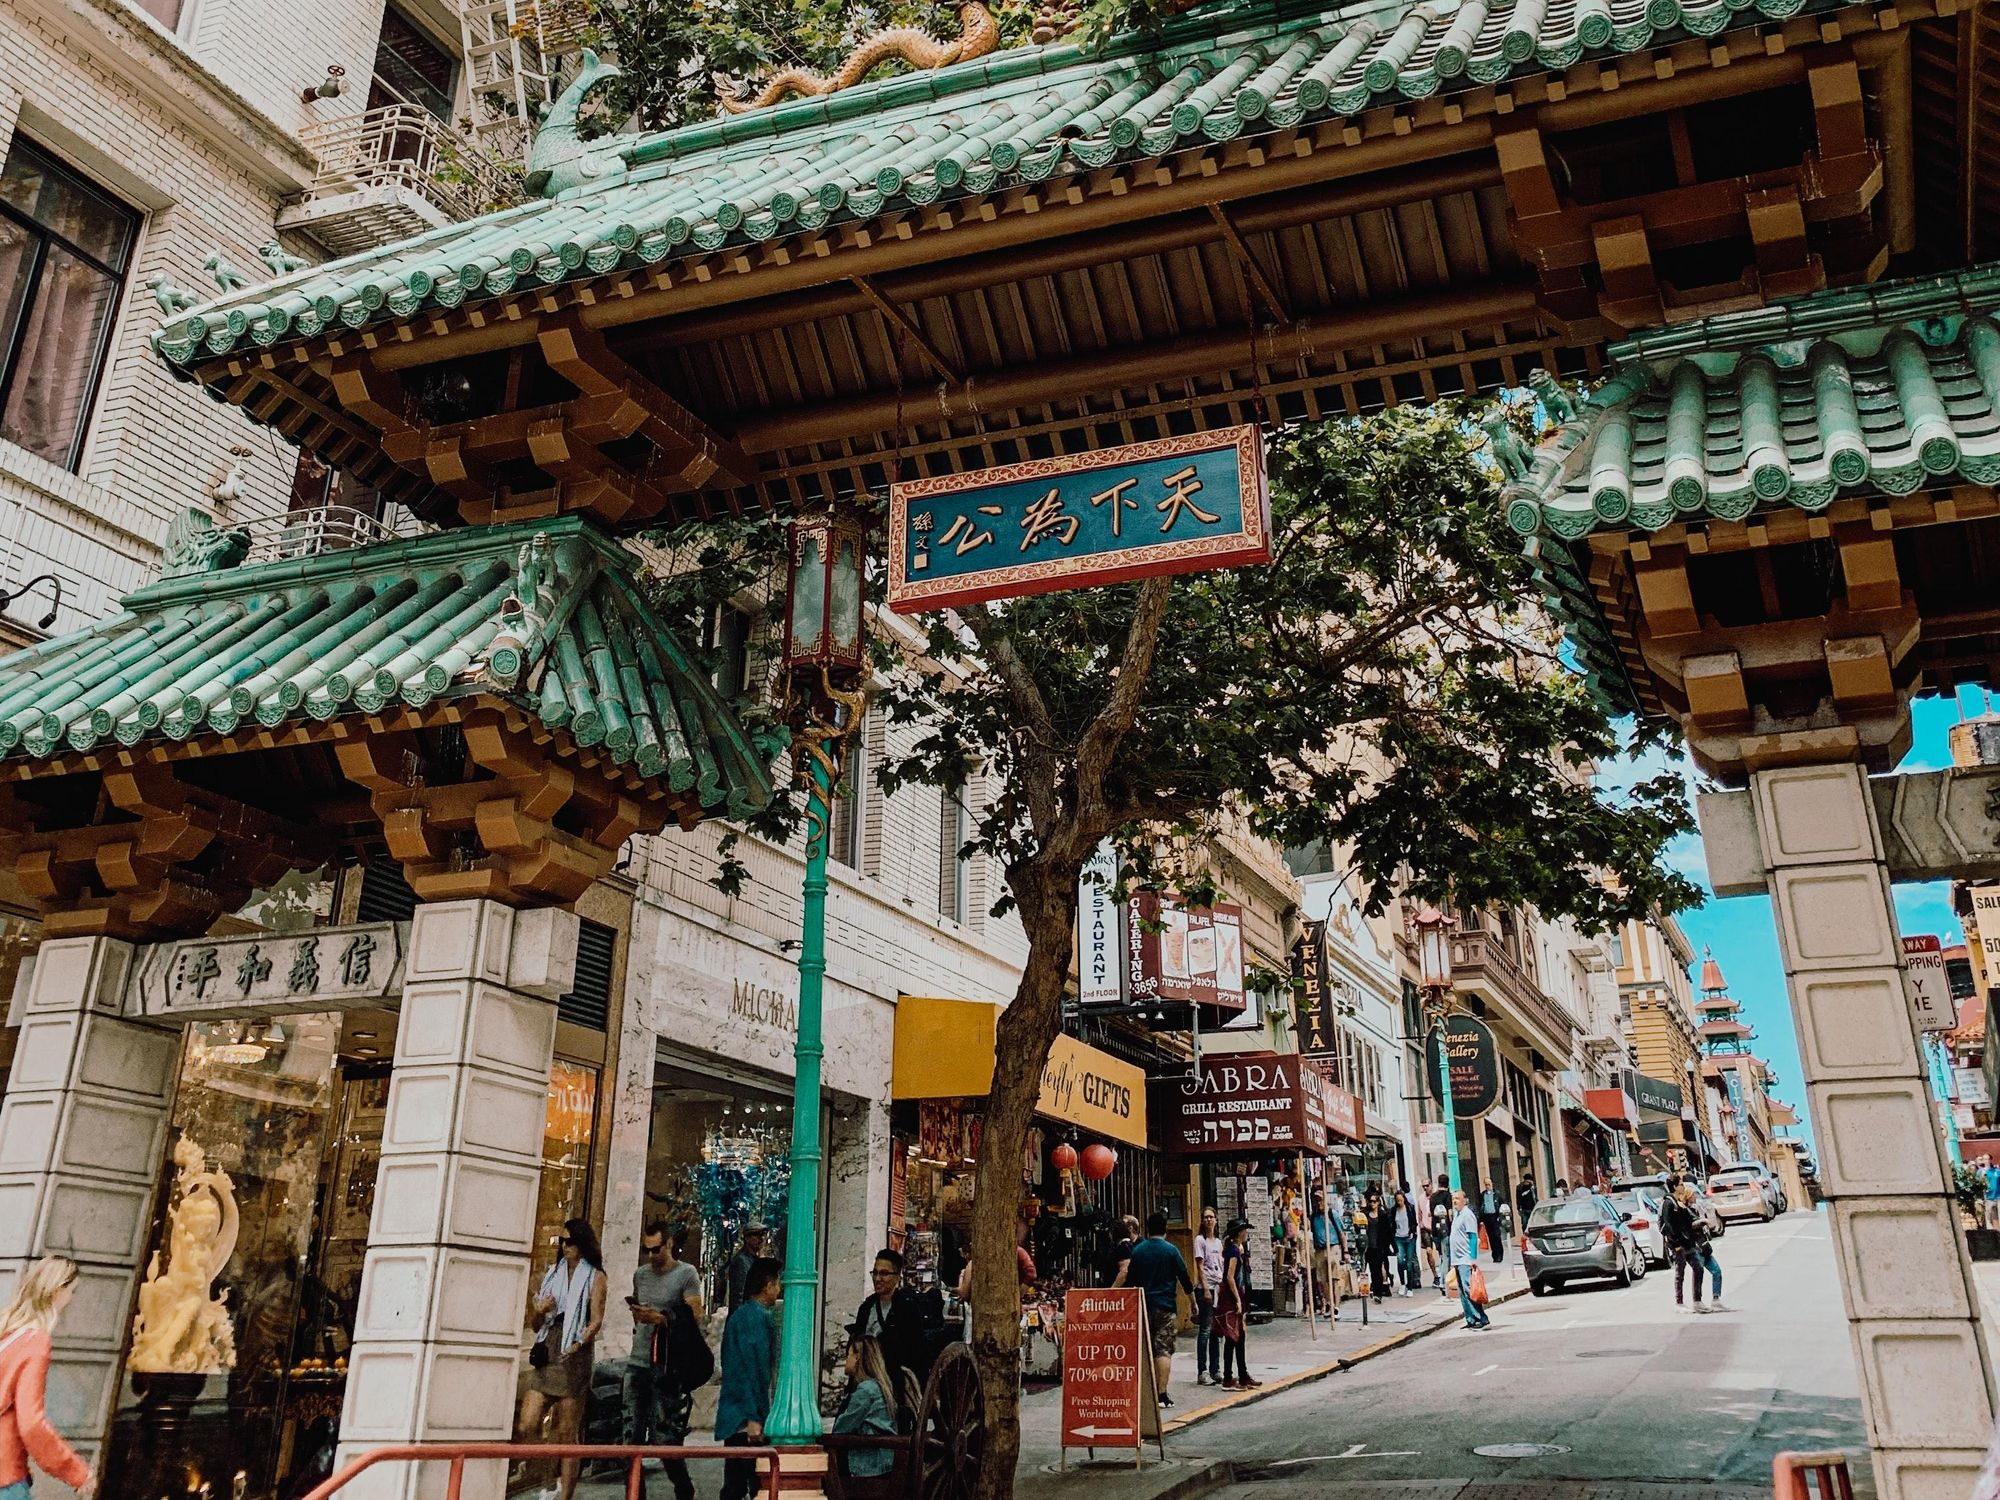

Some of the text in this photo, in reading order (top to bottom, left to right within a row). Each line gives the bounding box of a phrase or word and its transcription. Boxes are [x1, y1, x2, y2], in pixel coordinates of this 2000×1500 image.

[1092, 877, 1106, 986] ESTAURANT
[1128, 897, 1144, 983] CATERING
[1096, 989, 1118, 997] FLOOR
[1299, 926, 1326, 1050] VENEZIA
[731, 977, 799, 1035] MICHA
[1446, 1030, 1480, 1043] enezia
[1181, 1064, 1291, 1096] SABRA
[1083, 1071, 1131, 1119] GIFTS
[1182, 1102, 1216, 1115] GRILL
[1217, 1098, 1293, 1114] RESTAURANT
[1661, 1098, 1680, 1112] PLAZA
[1079, 1297, 1126, 1313] Michael
[1068, 1322, 1137, 1332] INVENTORY SALE
[1078, 1344, 1127, 1361] UP TO
[1068, 1366, 1136, 1383] 70% OFF
[1071, 1395, 1131, 1408] Free Shipping
[1078, 1408, 1124, 1419] Worldwide
